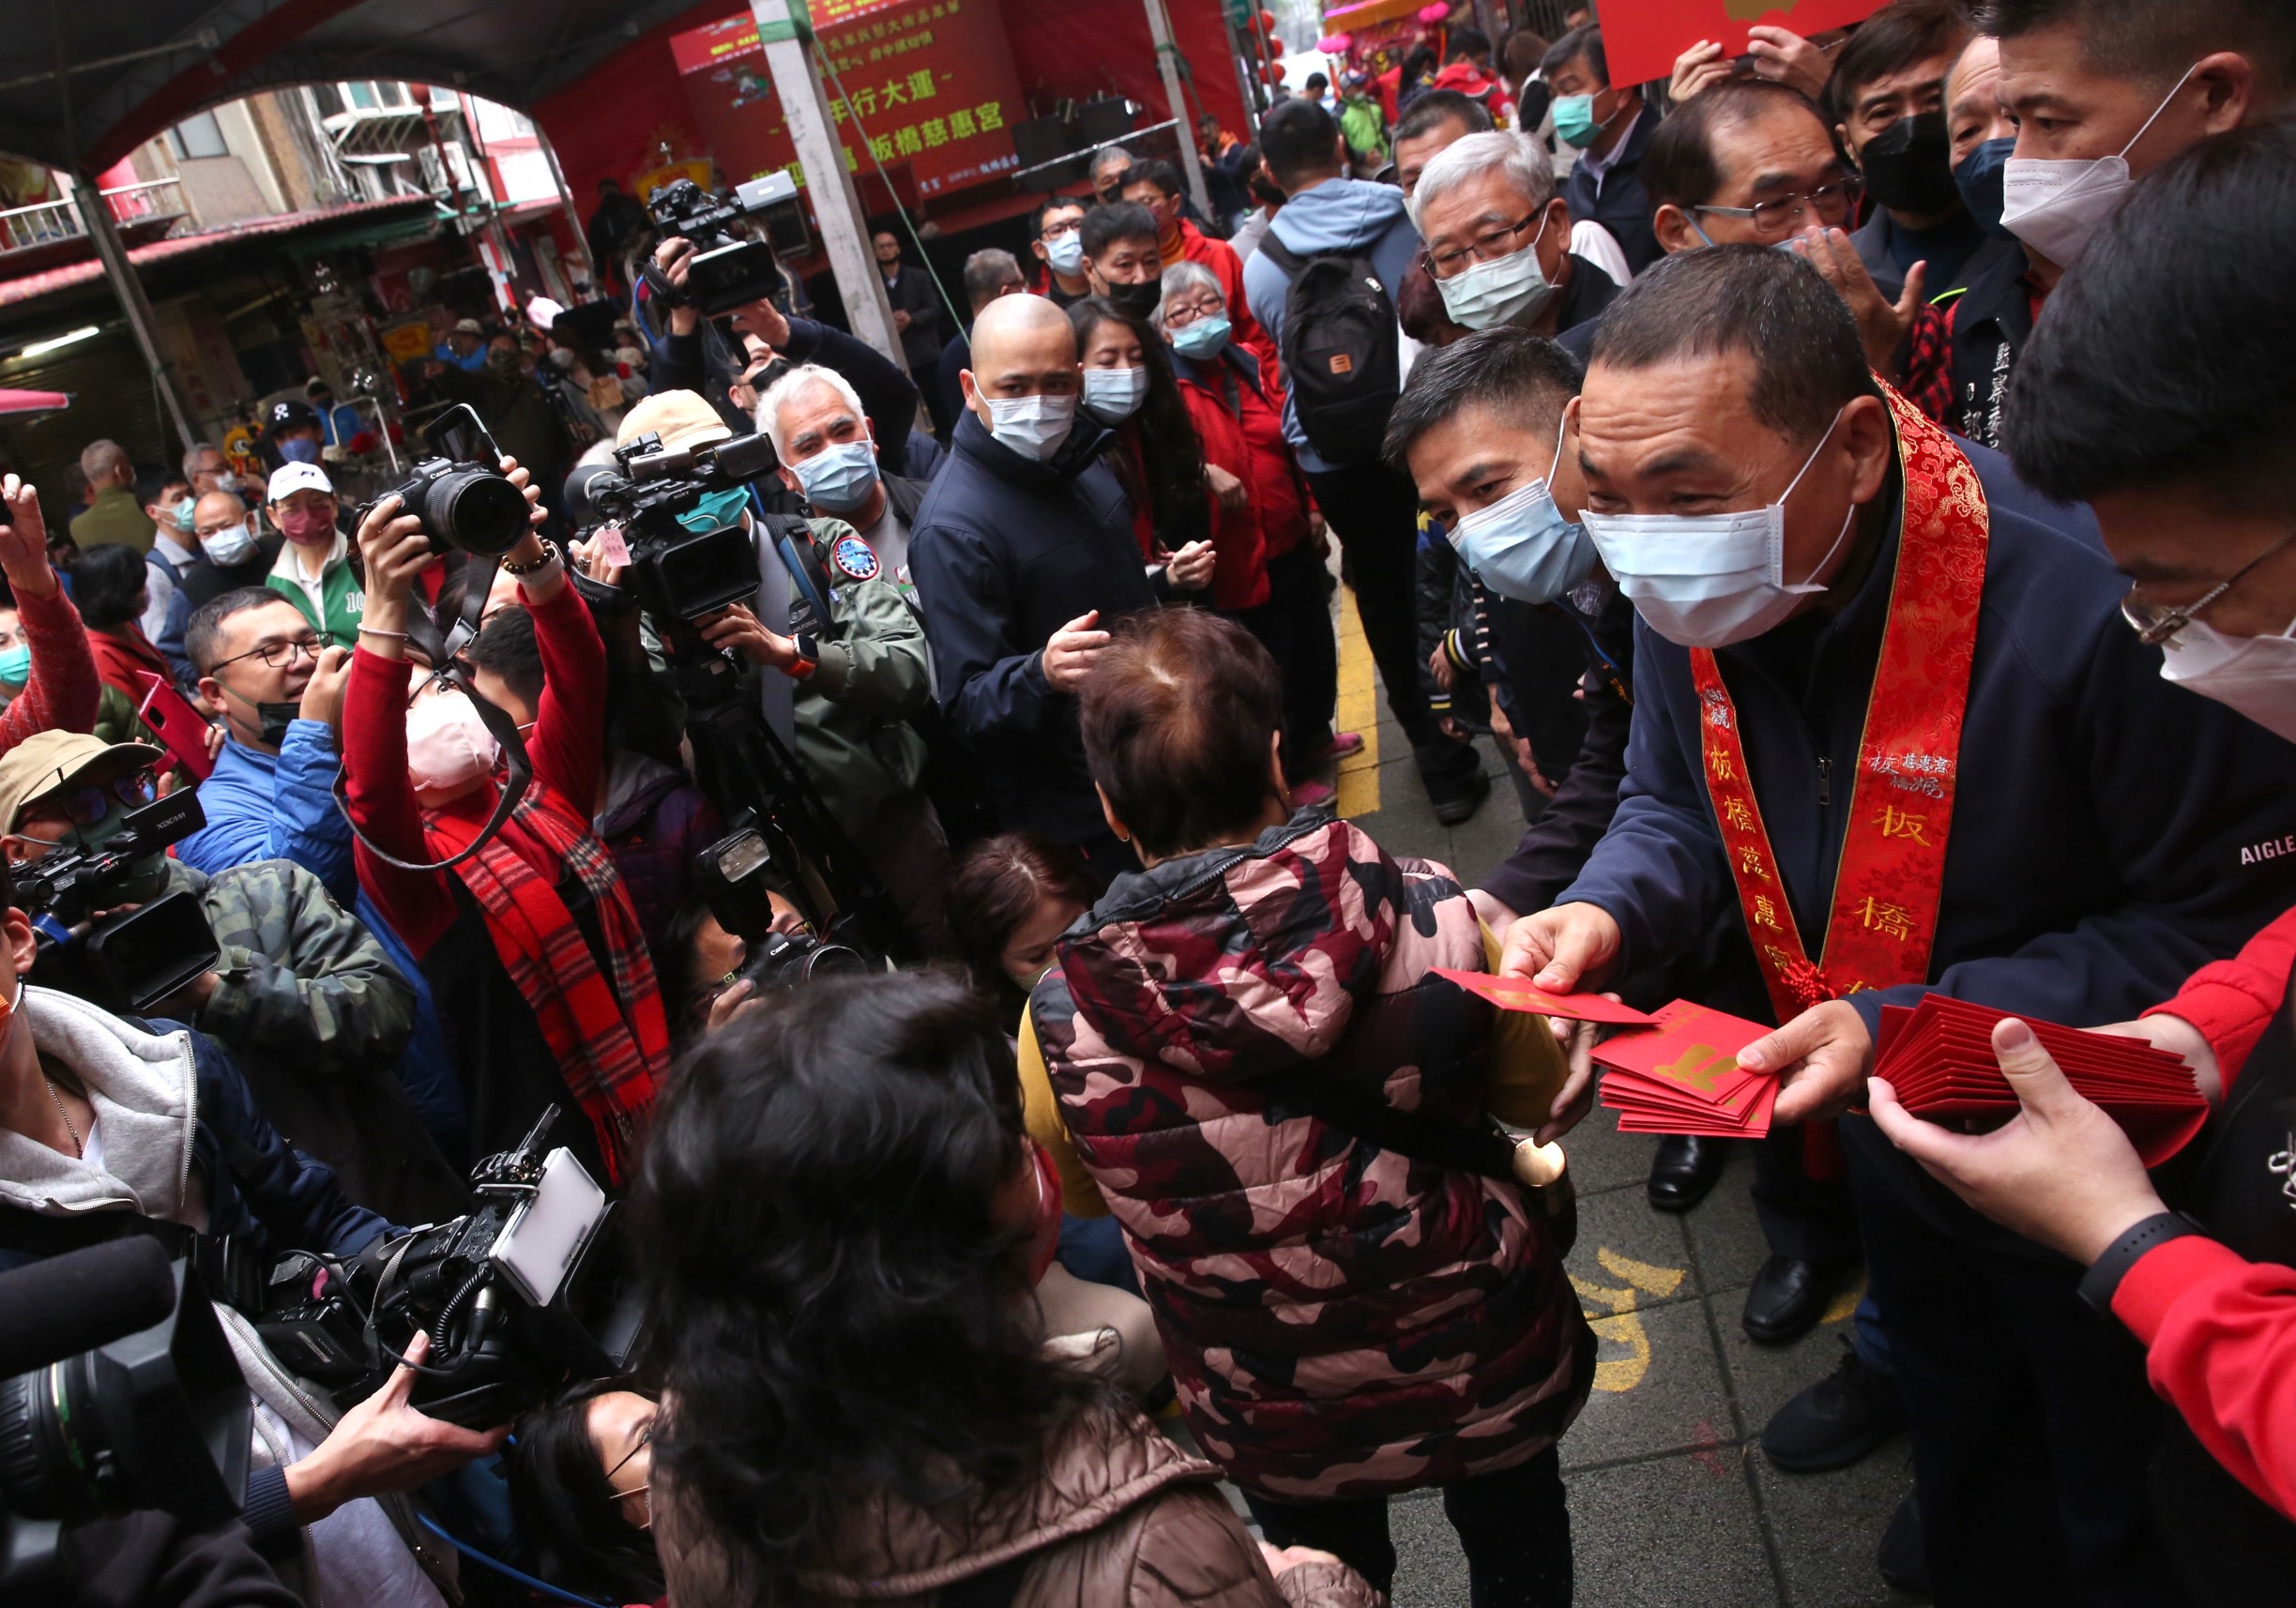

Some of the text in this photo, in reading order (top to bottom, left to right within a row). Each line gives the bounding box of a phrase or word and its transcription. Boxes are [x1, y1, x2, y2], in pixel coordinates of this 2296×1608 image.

[870, 101, 1004, 162] 板橋慈惠宮
[429, 467, 453, 479] Canon
[673, 491, 690, 500] SONY
[157, 812, 187, 830] XDCAM
[1710, 745, 1791, 972] 板橋慈惠宮
[2241, 835, 2296, 865] AIGLE
[101, 860, 120, 873] SONY
[1844, 804, 1932, 992] 板橋
[769, 941, 790, 956] Canon
